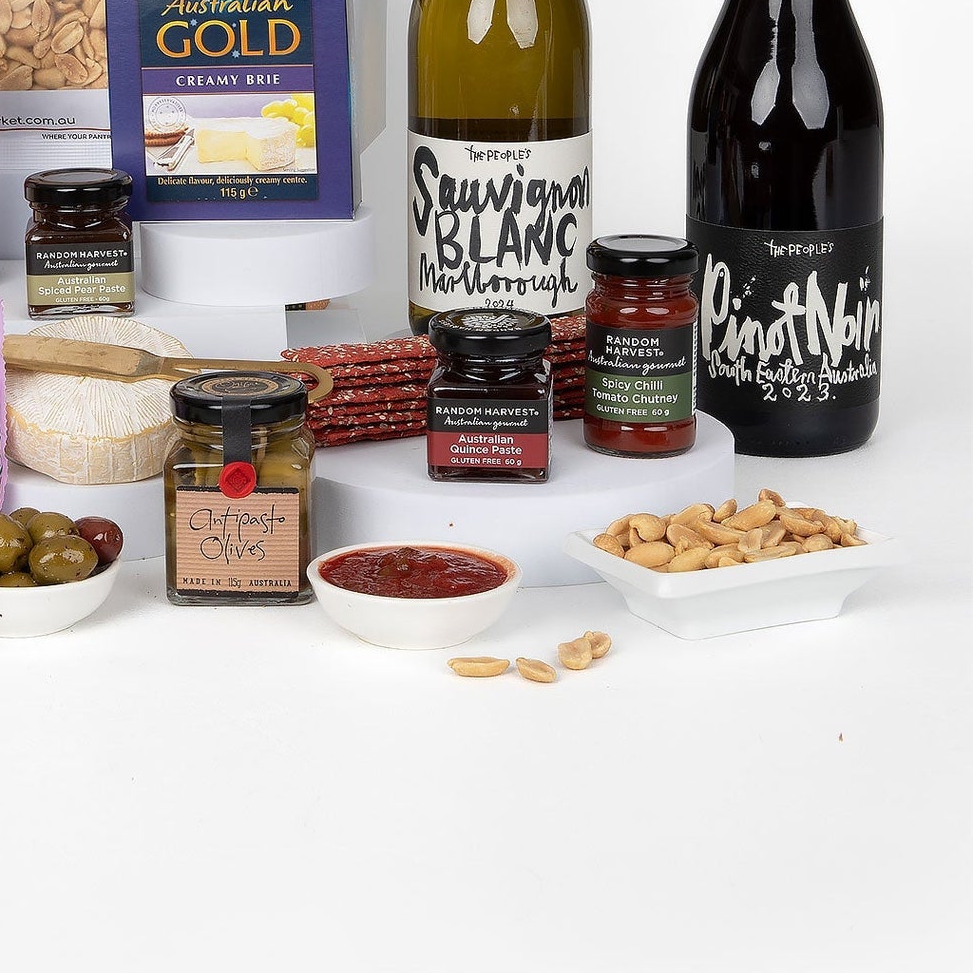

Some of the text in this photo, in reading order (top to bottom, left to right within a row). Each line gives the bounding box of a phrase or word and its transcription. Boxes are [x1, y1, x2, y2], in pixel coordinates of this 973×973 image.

[155, 18, 302, 59] GOLD
[175, 74, 281, 86] CREAMY BRIE
[487, 148, 532, 162] PEOPLE'S
[157, 176, 308, 186] Delicate flavour, deliciously creamy centre.
[220, 187, 246, 199] 115 g
[412, 145, 590, 237] Sauvignon
[435, 207, 578, 272] BLANC
[36, 249, 125, 260] RANDOM HARVEST
[788, 241, 834, 257] PEOPLE'S
[43, 259, 119, 272] Australian gourmet
[57, 276, 107, 286] Australian
[419, 252, 578, 309] Marlborough
[38, 284, 126, 296] Spiced Pear Paste
[484, 298, 515, 308] 2024
[701, 253, 881, 368] Pinot Noir
[606, 335, 660, 347] RANDOM
[605, 345, 660, 357] HARVEST
[587, 349, 687, 376] Australian gourmet
[708, 349, 878, 386] South Eastern Australia
[601, 377, 663, 391] Spicy Chilli
[592, 387, 679, 404] Tomato Chutney
[435, 406, 535, 416] RANDOM HARVEST
[596, 404, 670, 417] GLUTEN FREE 60 g
[443, 415, 529, 431] Australian gourmet
[458, 434, 514, 444] Australian
[449, 444, 523, 455] Quince Paste
[450, 456, 481, 464] GLUTEN
[189, 504, 286, 543] Antipasto
[200, 533, 266, 565] Olives
[182, 577, 207, 586] MADE
[211, 578, 221, 586] IN
[248, 579, 292, 587] AUSTRALIA
